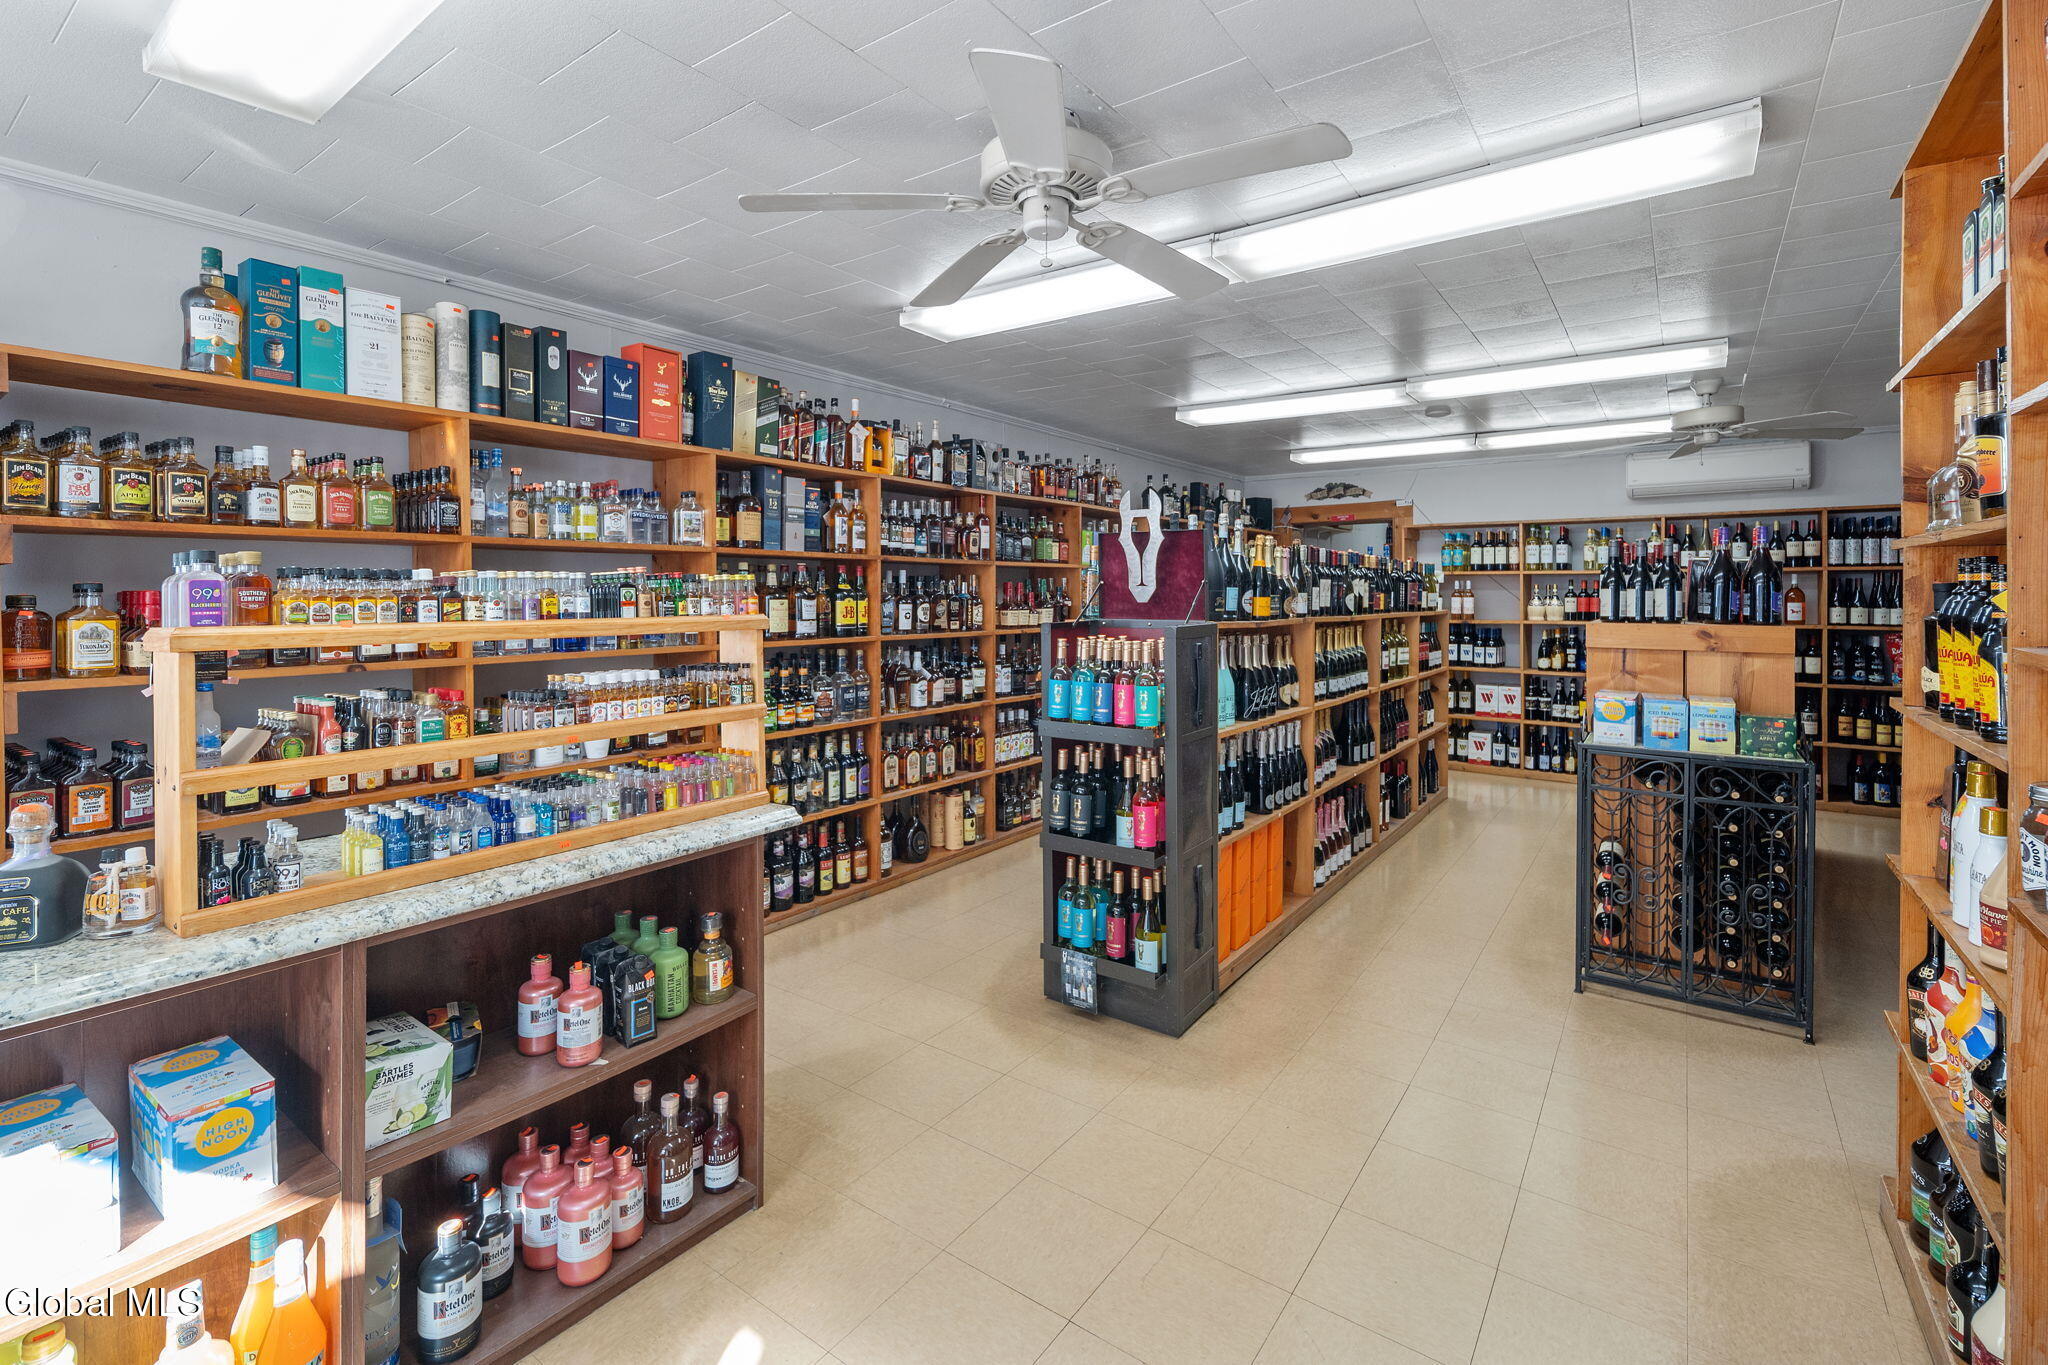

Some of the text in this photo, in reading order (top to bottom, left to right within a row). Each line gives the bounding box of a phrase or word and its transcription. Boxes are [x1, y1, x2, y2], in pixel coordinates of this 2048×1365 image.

[256, 290, 292, 302] GLENLIVET
[305, 296, 339, 307] GLENLIVET
[198, 315, 234, 326] GLENLIVET
[364, 314, 396, 324] BALVENIE
[12, 464, 43, 476] JIM BEAM
[118, 473, 147, 484] JIM BEAM
[175, 477, 201, 488] JIM BEAM
[192, 588, 212, 599] 99
[1939, 646, 1954, 659] LÚA
[1954, 649, 1973, 666] LÚA
[1980, 673, 1995, 687] LÚA
[1481, 692, 1493, 704] W
[1504, 693, 1516, 705] W
[1474, 740, 1486, 752] W
[2029, 841, 2041, 868] MOON
[2, 907, 30, 916] CAFE
[629, 981, 645, 993] BLACK
[1908, 991, 1926, 1001] BAIL
[531, 1009, 550, 1024] Ketel
[563, 1017, 591, 1031] Ketel One
[170, 1053, 215, 1070] NOON
[171, 1052, 209, 1066] HIGH
[376, 1063, 414, 1080] BARTLES
[382, 1070, 414, 1086] JAYMES
[206, 1116, 245, 1137] HIGH
[201, 1126, 248, 1148] NOON
[213, 1162, 241, 1175] VODKA
[662, 1197, 680, 1207] KNOB
[620, 1202, 633, 1218] Ketel
[540, 1214, 557, 1231] Ket
[580, 1224, 601, 1244] Ketel
[482, 1244, 510, 1266] Ketel One
[434, 1290, 476, 1320] Ketel One
[448, 1302, 472, 1316] COCKTAILS
